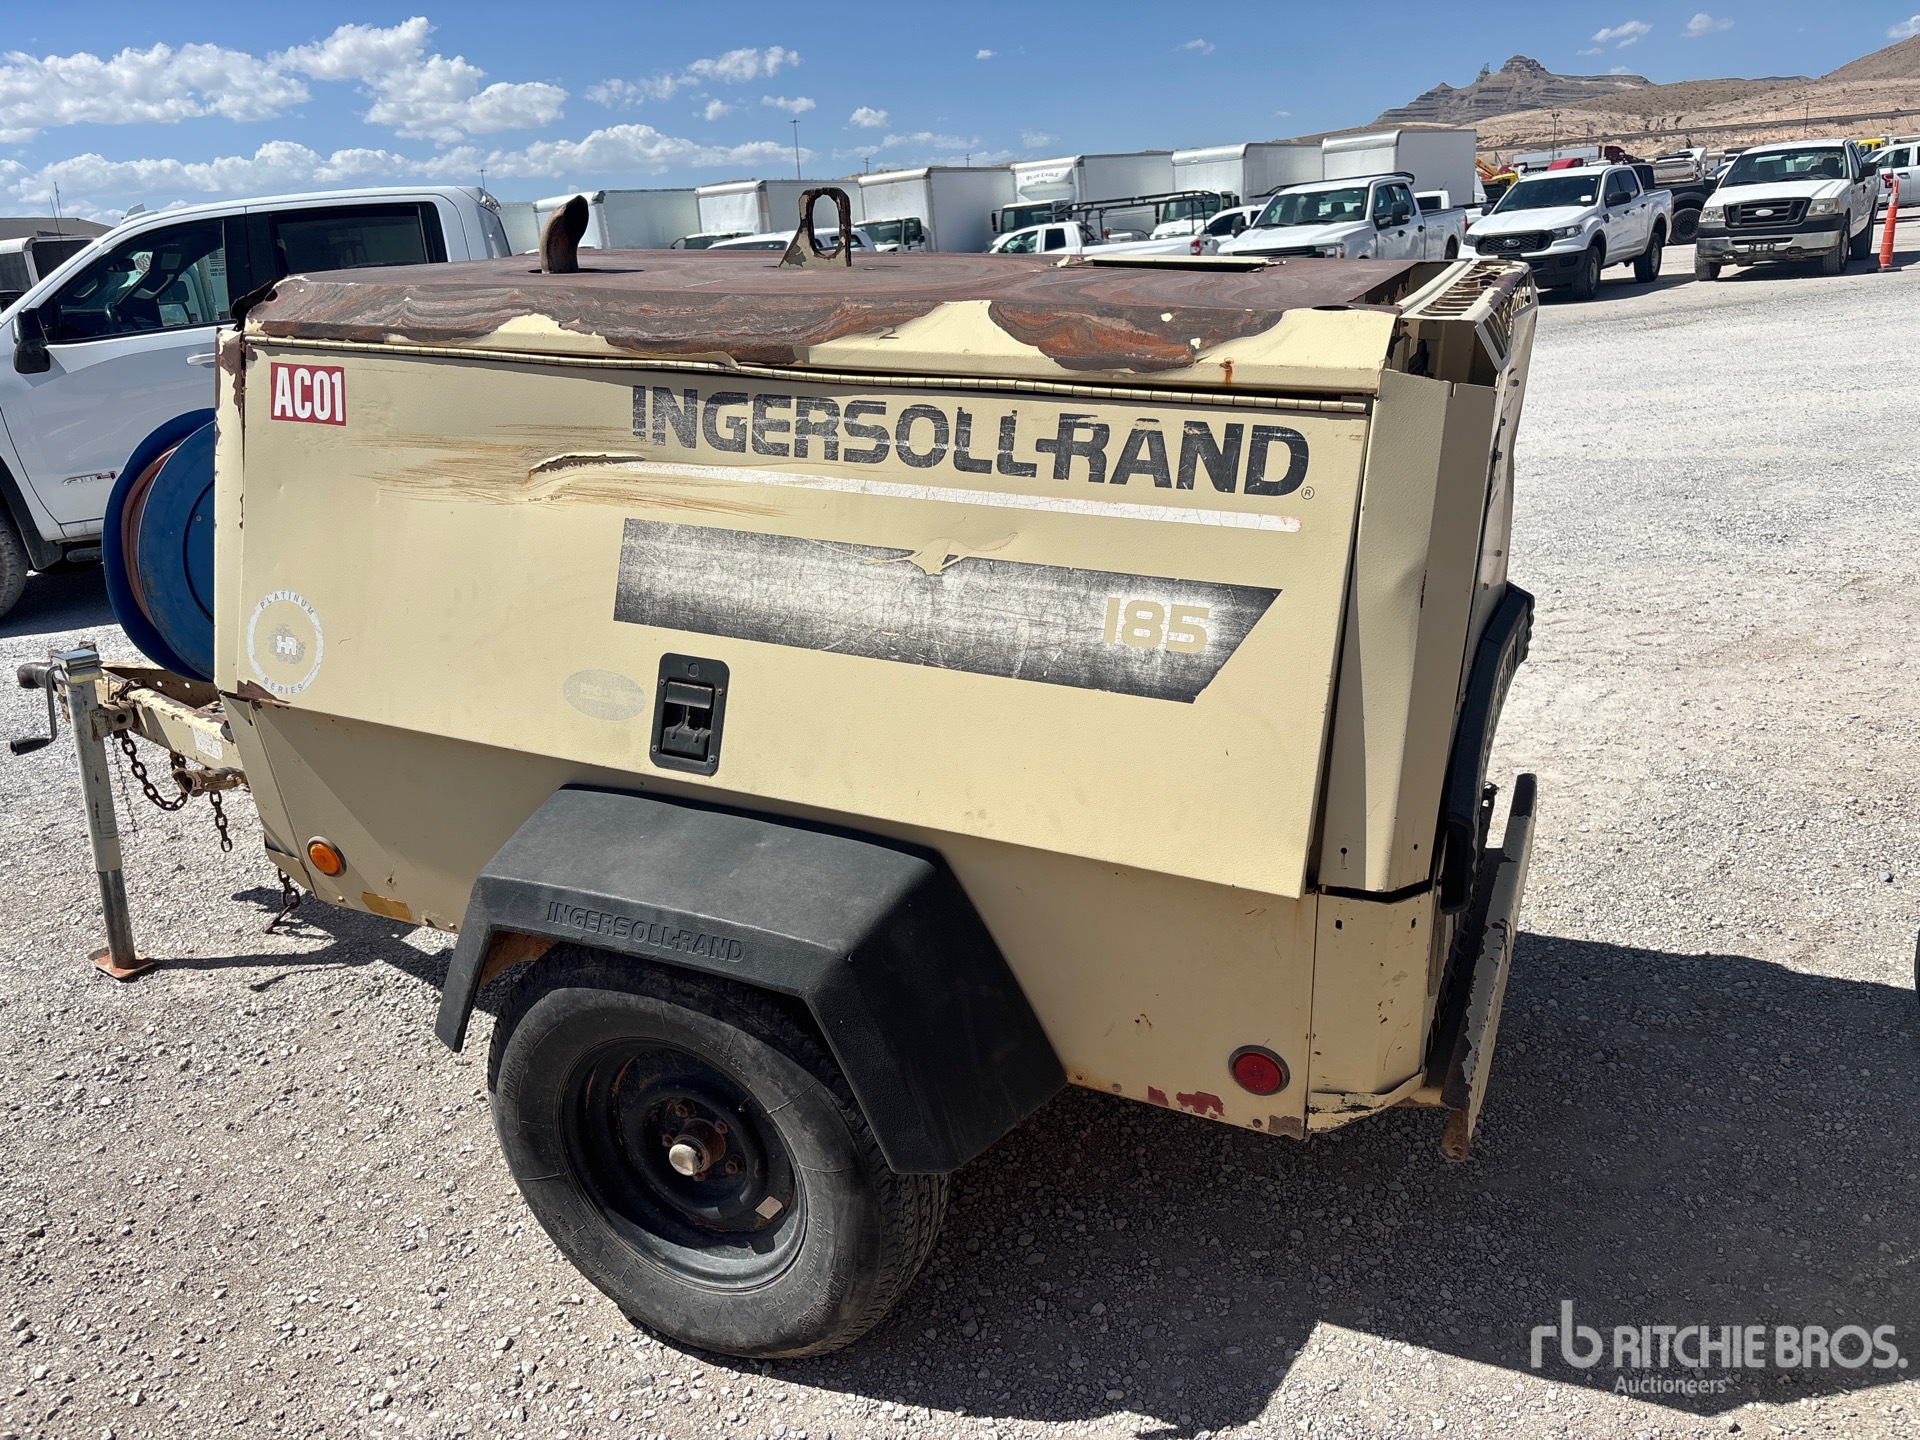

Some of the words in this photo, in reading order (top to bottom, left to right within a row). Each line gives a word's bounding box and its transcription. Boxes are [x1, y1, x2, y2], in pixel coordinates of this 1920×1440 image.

[273, 366, 344, 422] AC01
[632, 384, 1309, 497] INGERSOLL-RAND
[259, 591, 315, 616] PLATINUM
[1103, 596, 1211, 655] 185
[263, 676, 304, 695] SERIES
[546, 901, 746, 963] INGERSOLL-RAND
